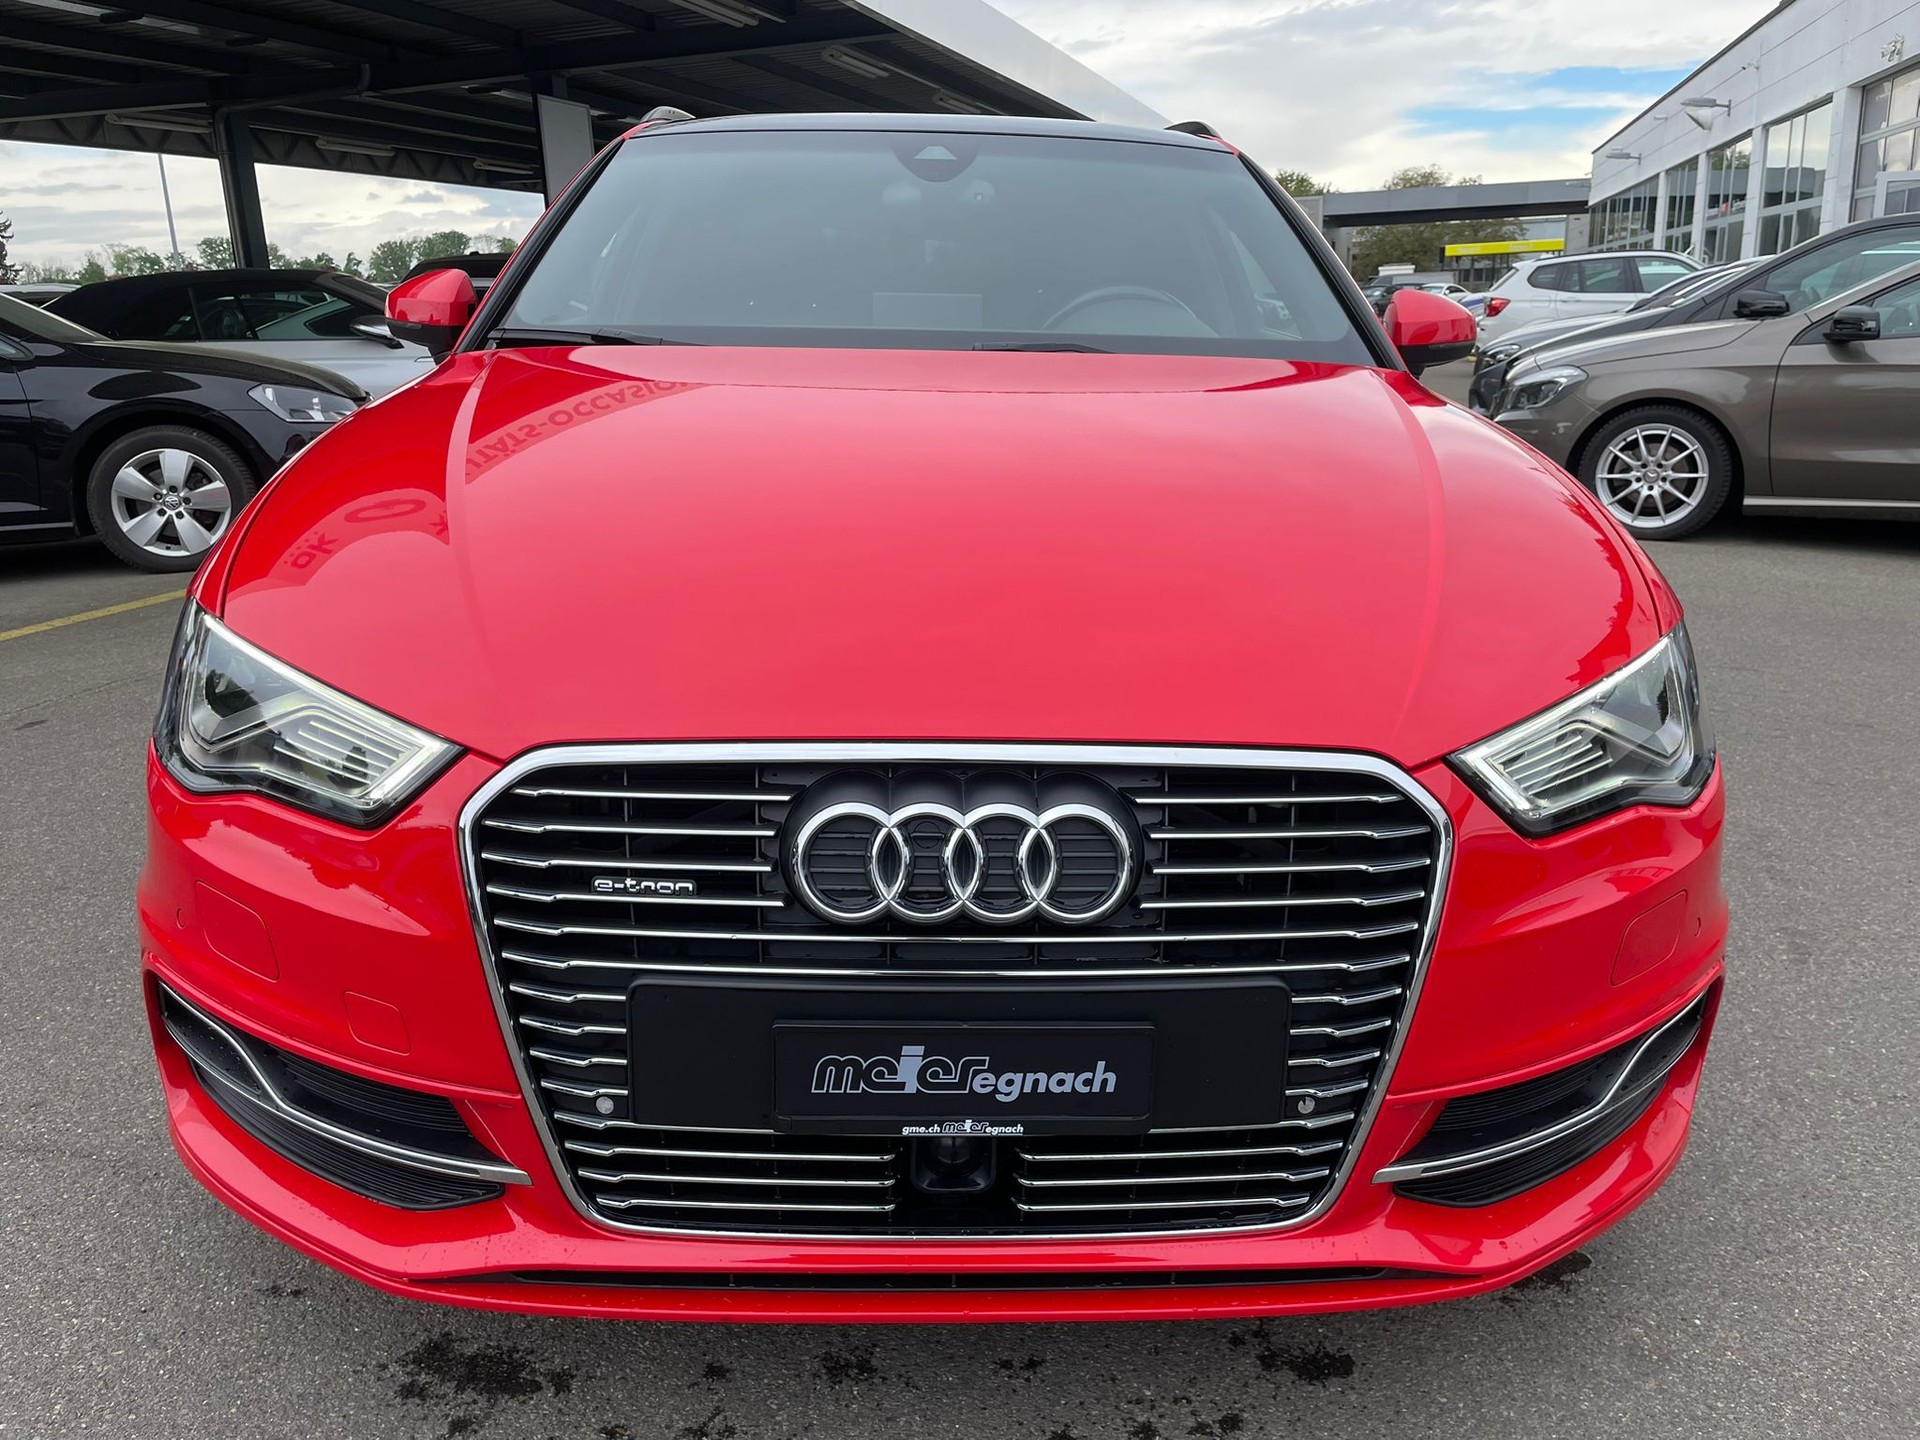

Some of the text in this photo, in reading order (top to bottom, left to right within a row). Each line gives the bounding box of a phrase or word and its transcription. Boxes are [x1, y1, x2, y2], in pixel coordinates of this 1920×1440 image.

[594, 878, 693, 895] e-tron
[971, 1060, 1117, 1103] egnach
[902, 1123, 940, 1136] gme.ch
[985, 1123, 1024, 1136] egnach
